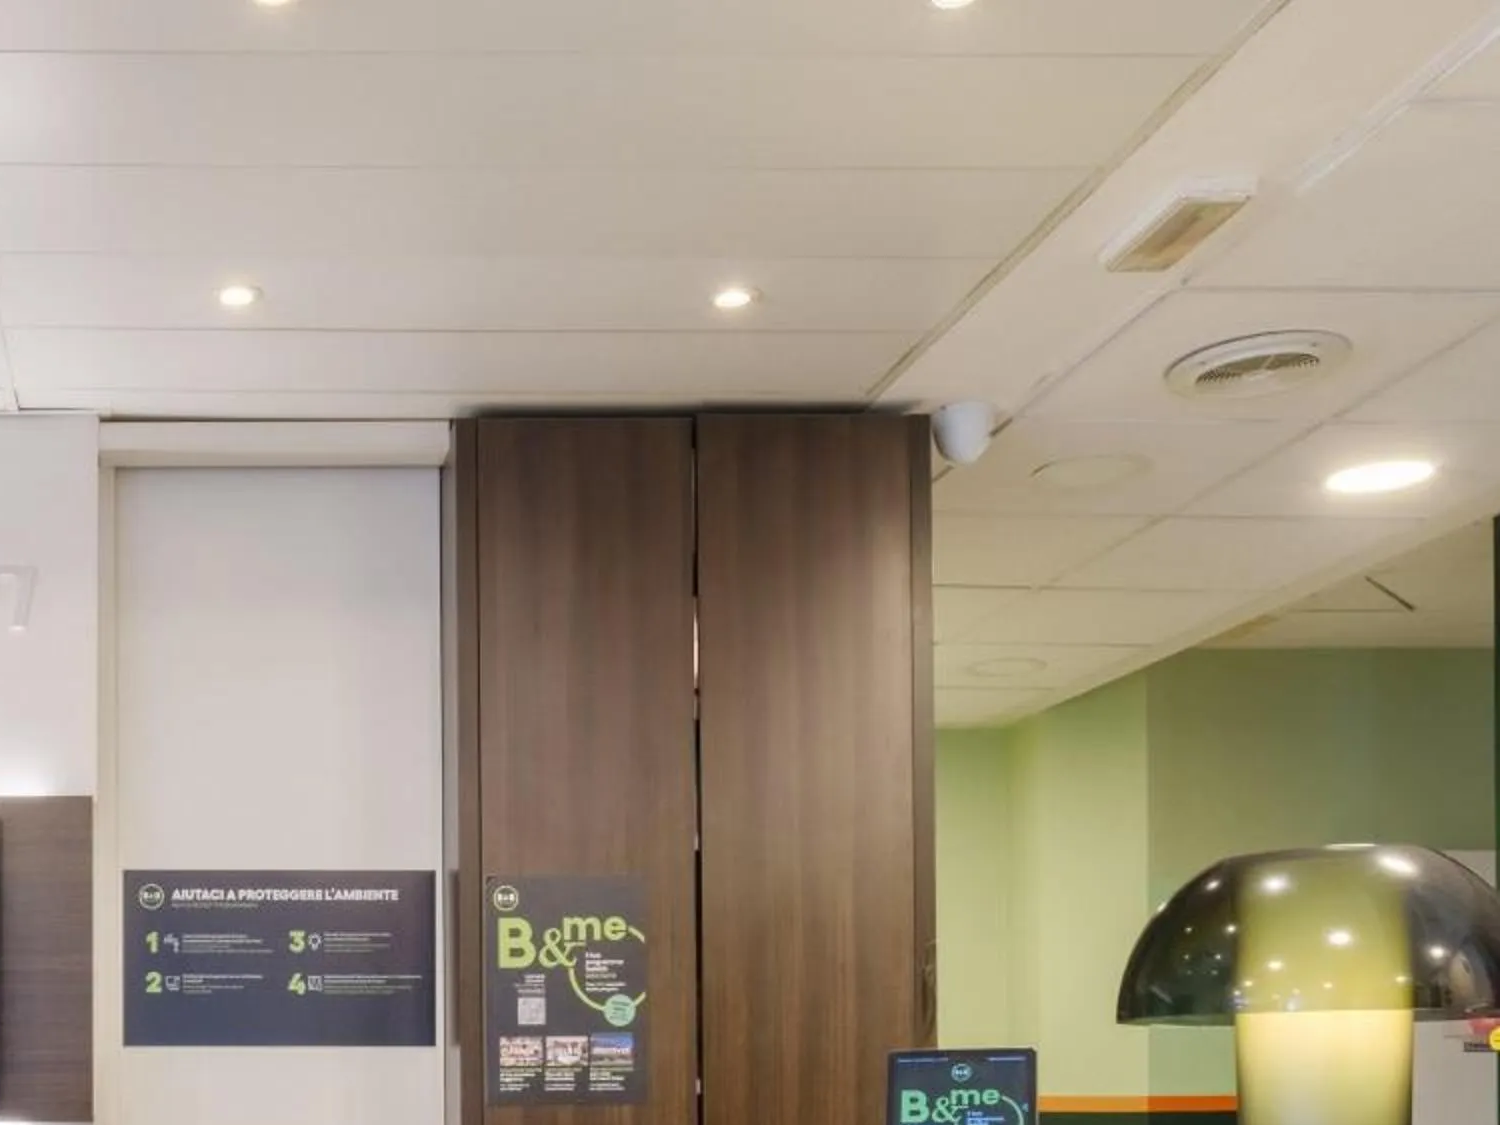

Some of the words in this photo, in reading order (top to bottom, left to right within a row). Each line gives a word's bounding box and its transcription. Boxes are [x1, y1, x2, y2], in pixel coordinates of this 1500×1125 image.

[171, 888, 224, 901] AIUTACI
[227, 888, 236, 901] A
[238, 888, 323, 901] PROTEGGERE
[325, 887, 399, 901] L'AMBIENTE
[145, 931, 159, 953] 1
[288, 930, 305, 953] 3
[497, 915, 628, 968] B&me
[145, 971, 162, 993] 2
[287, 972, 306, 995] 4
[900, 1088, 1002, 1123] B&me
